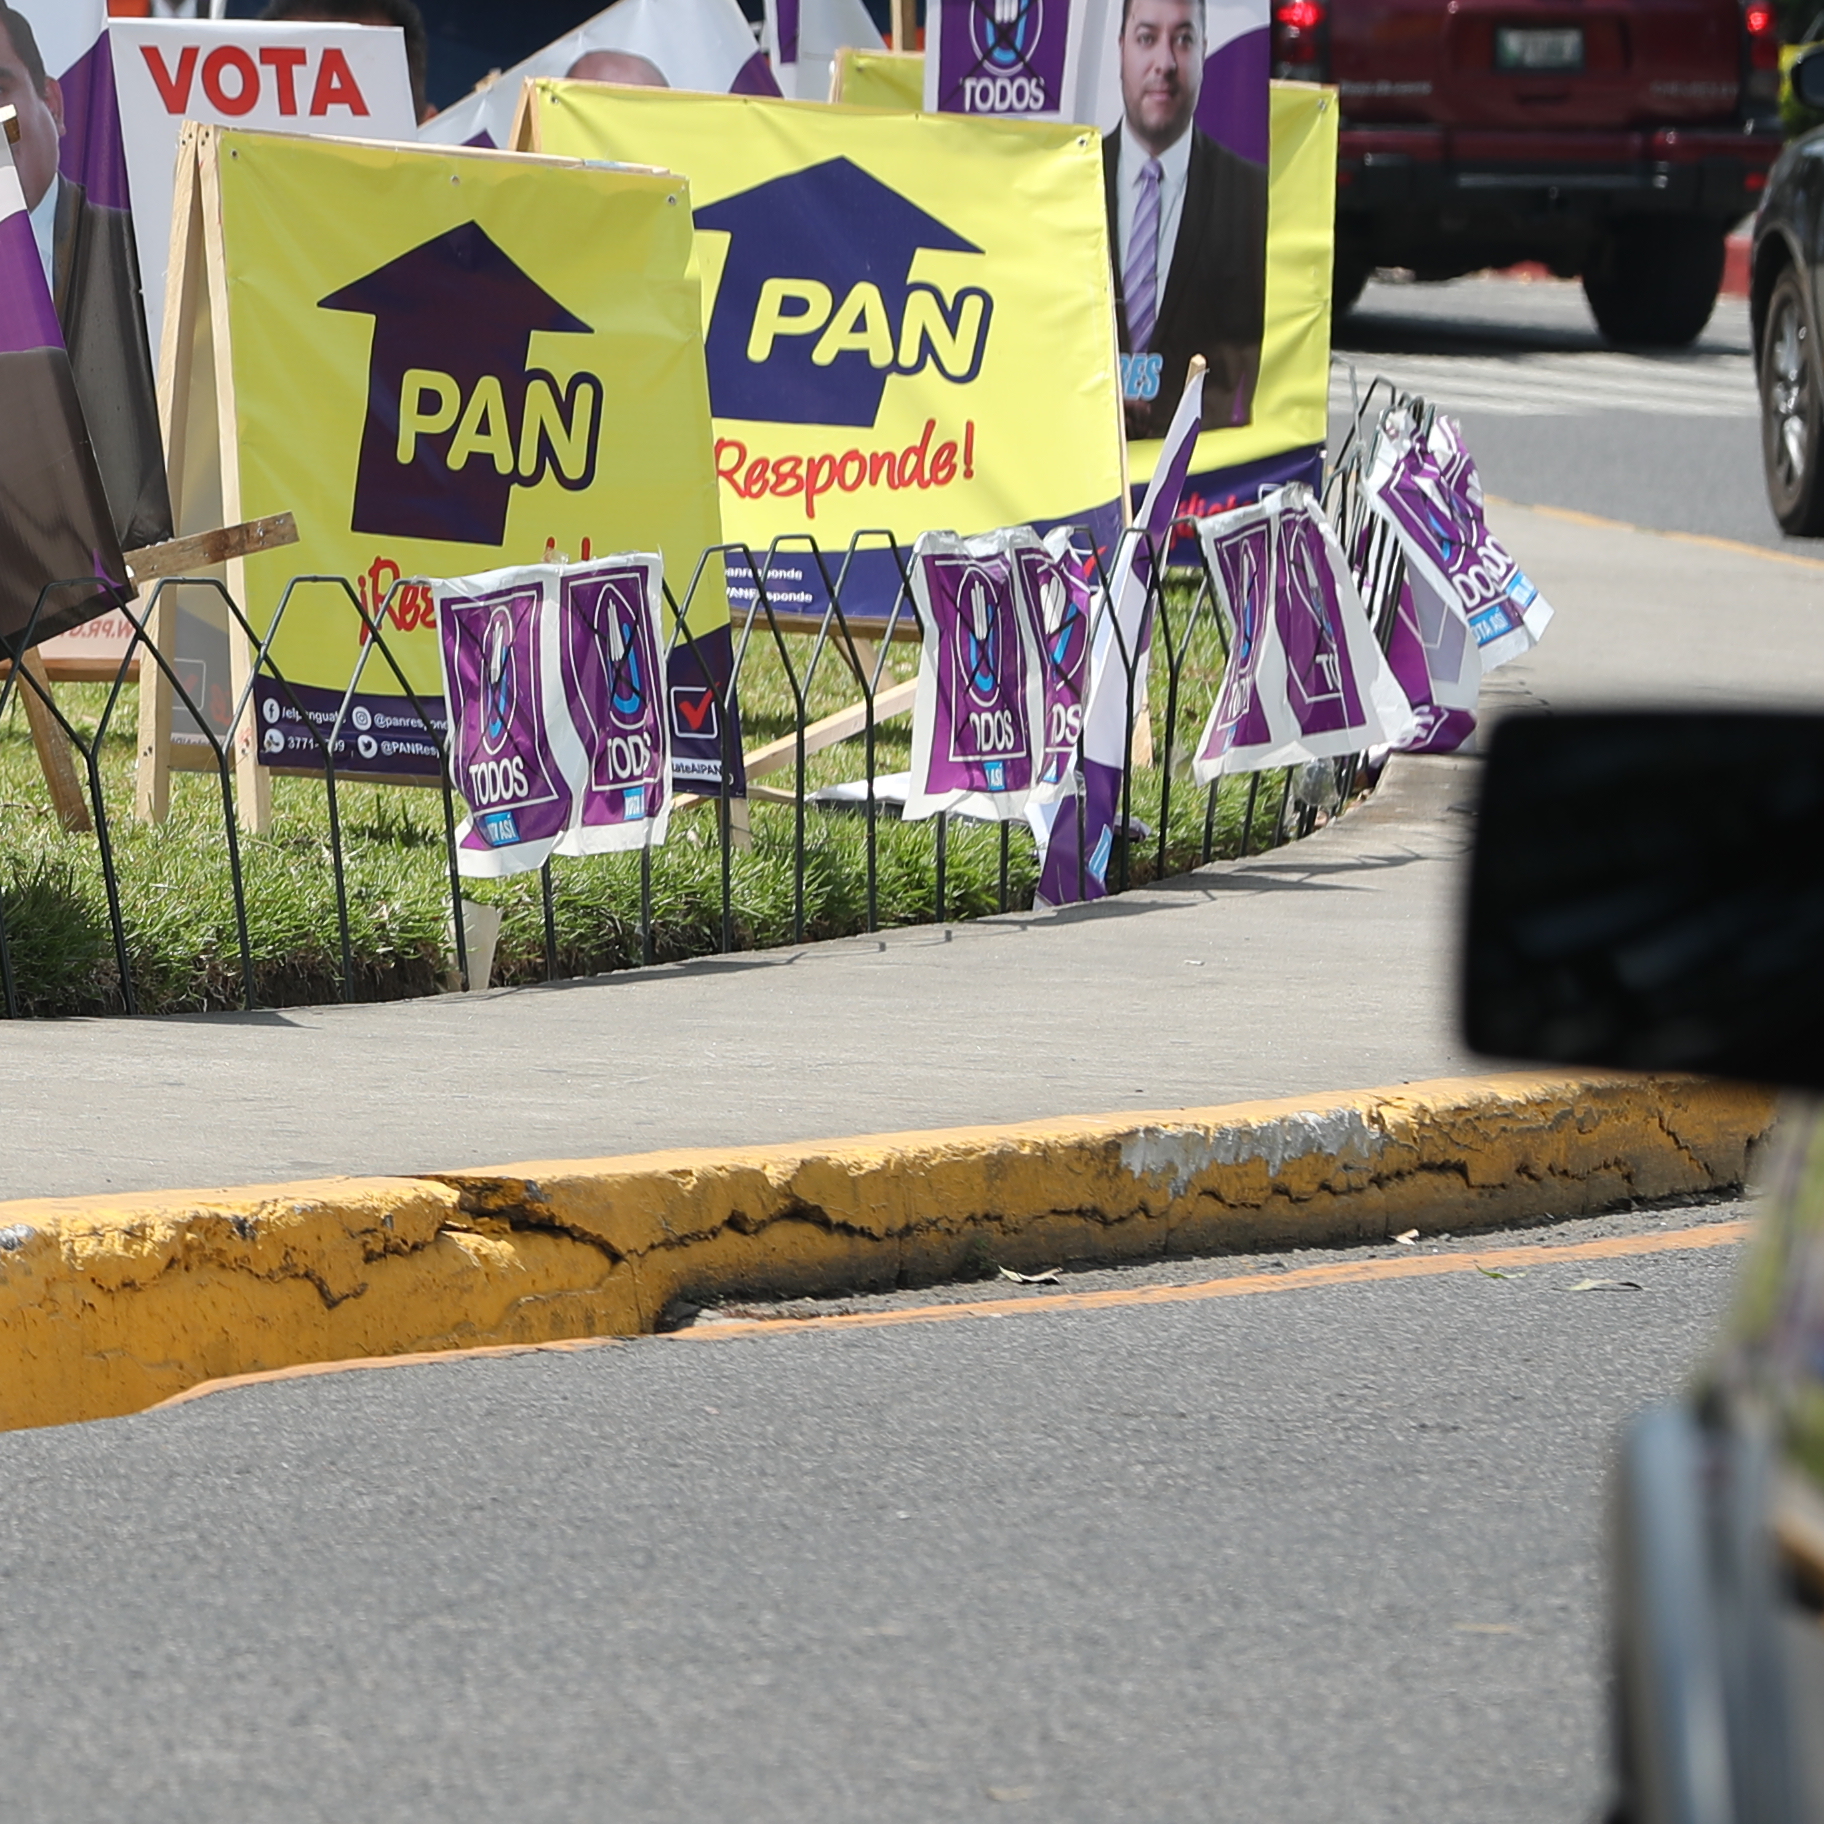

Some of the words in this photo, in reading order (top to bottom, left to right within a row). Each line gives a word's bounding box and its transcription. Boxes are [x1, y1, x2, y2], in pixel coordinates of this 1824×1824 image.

[140, 45, 370, 117] VOTA
[959, 75, 1045, 113] TODOS
[746, 277, 992, 382] PAN
[395, 368, 602, 492] PAN
[468, 754, 529, 807] TODOS
